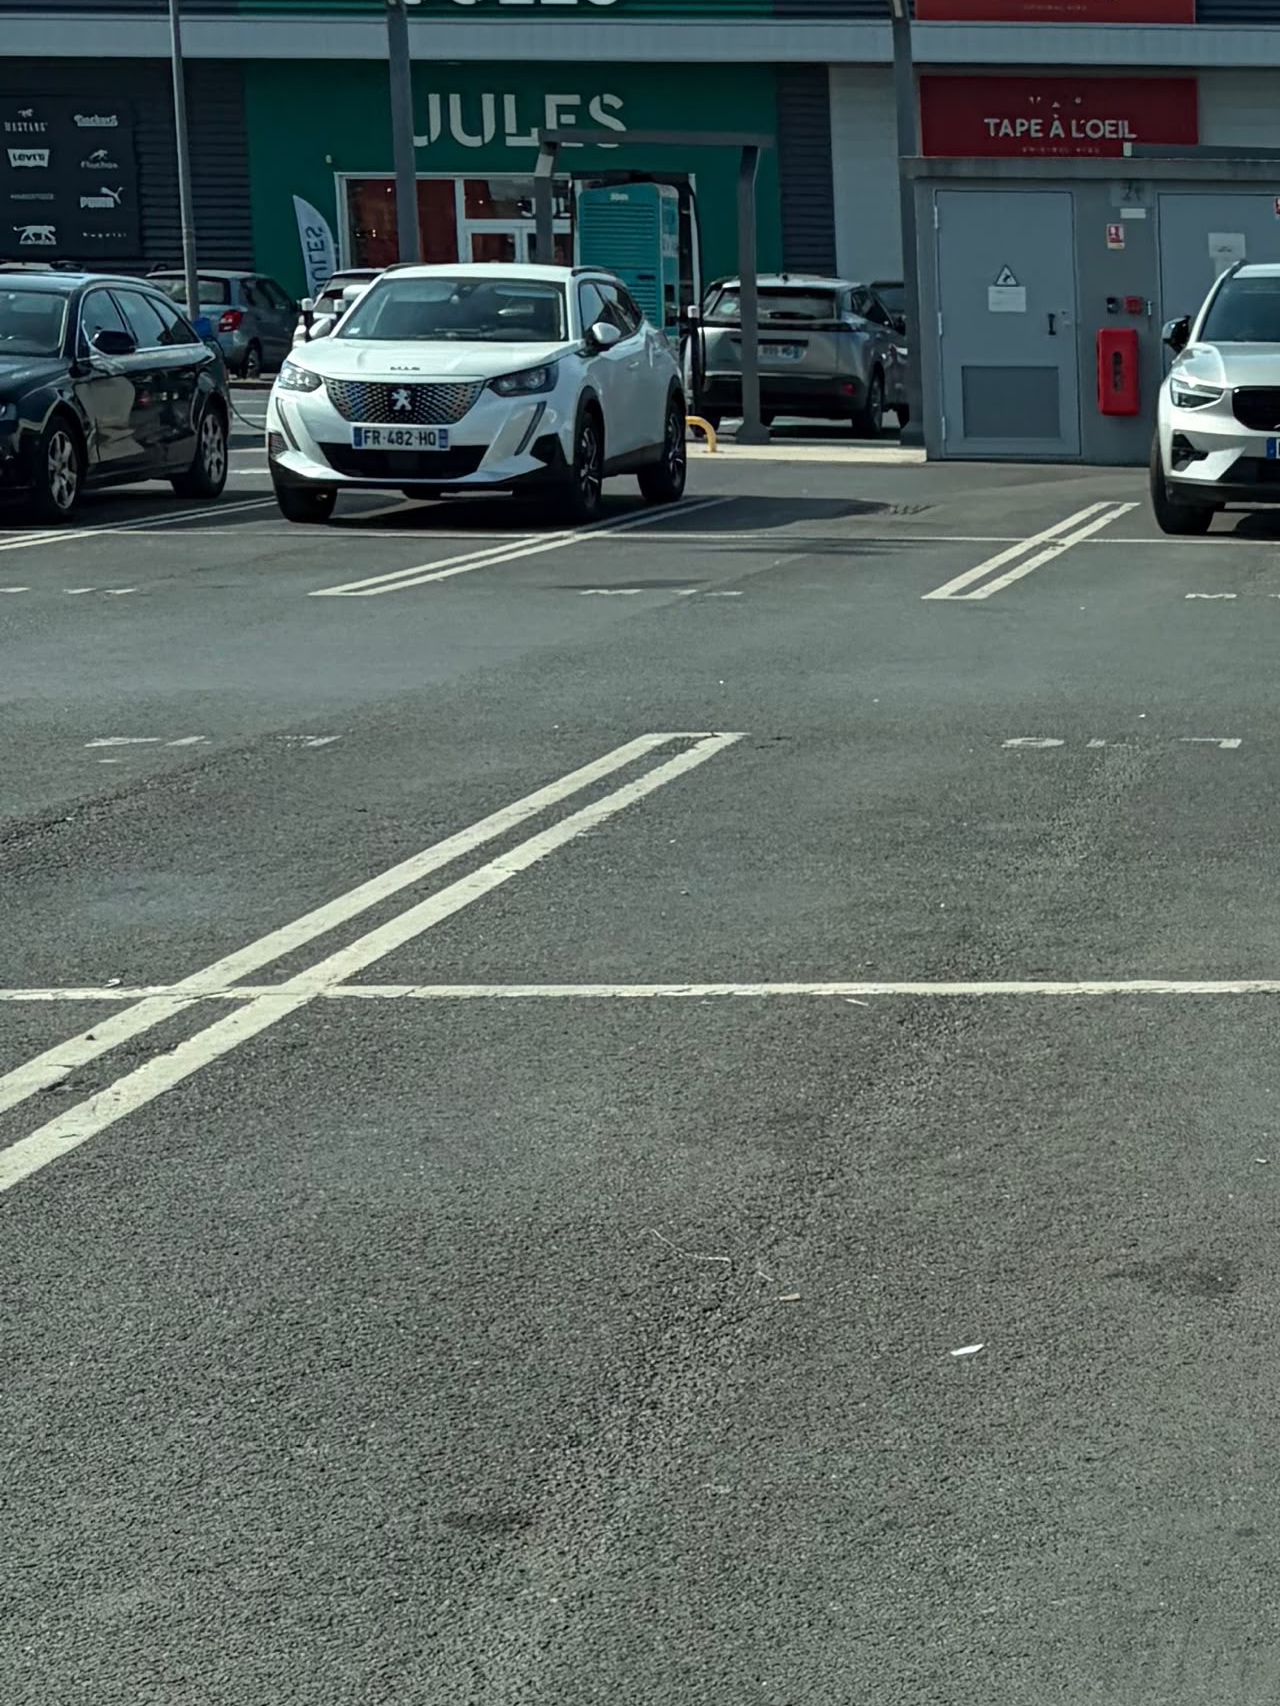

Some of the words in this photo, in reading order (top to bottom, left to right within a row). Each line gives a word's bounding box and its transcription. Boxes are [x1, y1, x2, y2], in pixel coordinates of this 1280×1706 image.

[413, 93, 628, 147] JULES
[983, 118, 1044, 137] TAPE
[1050, 113, 1065, 138] À
[1071, 119, 1138, 139] L'OEIL
